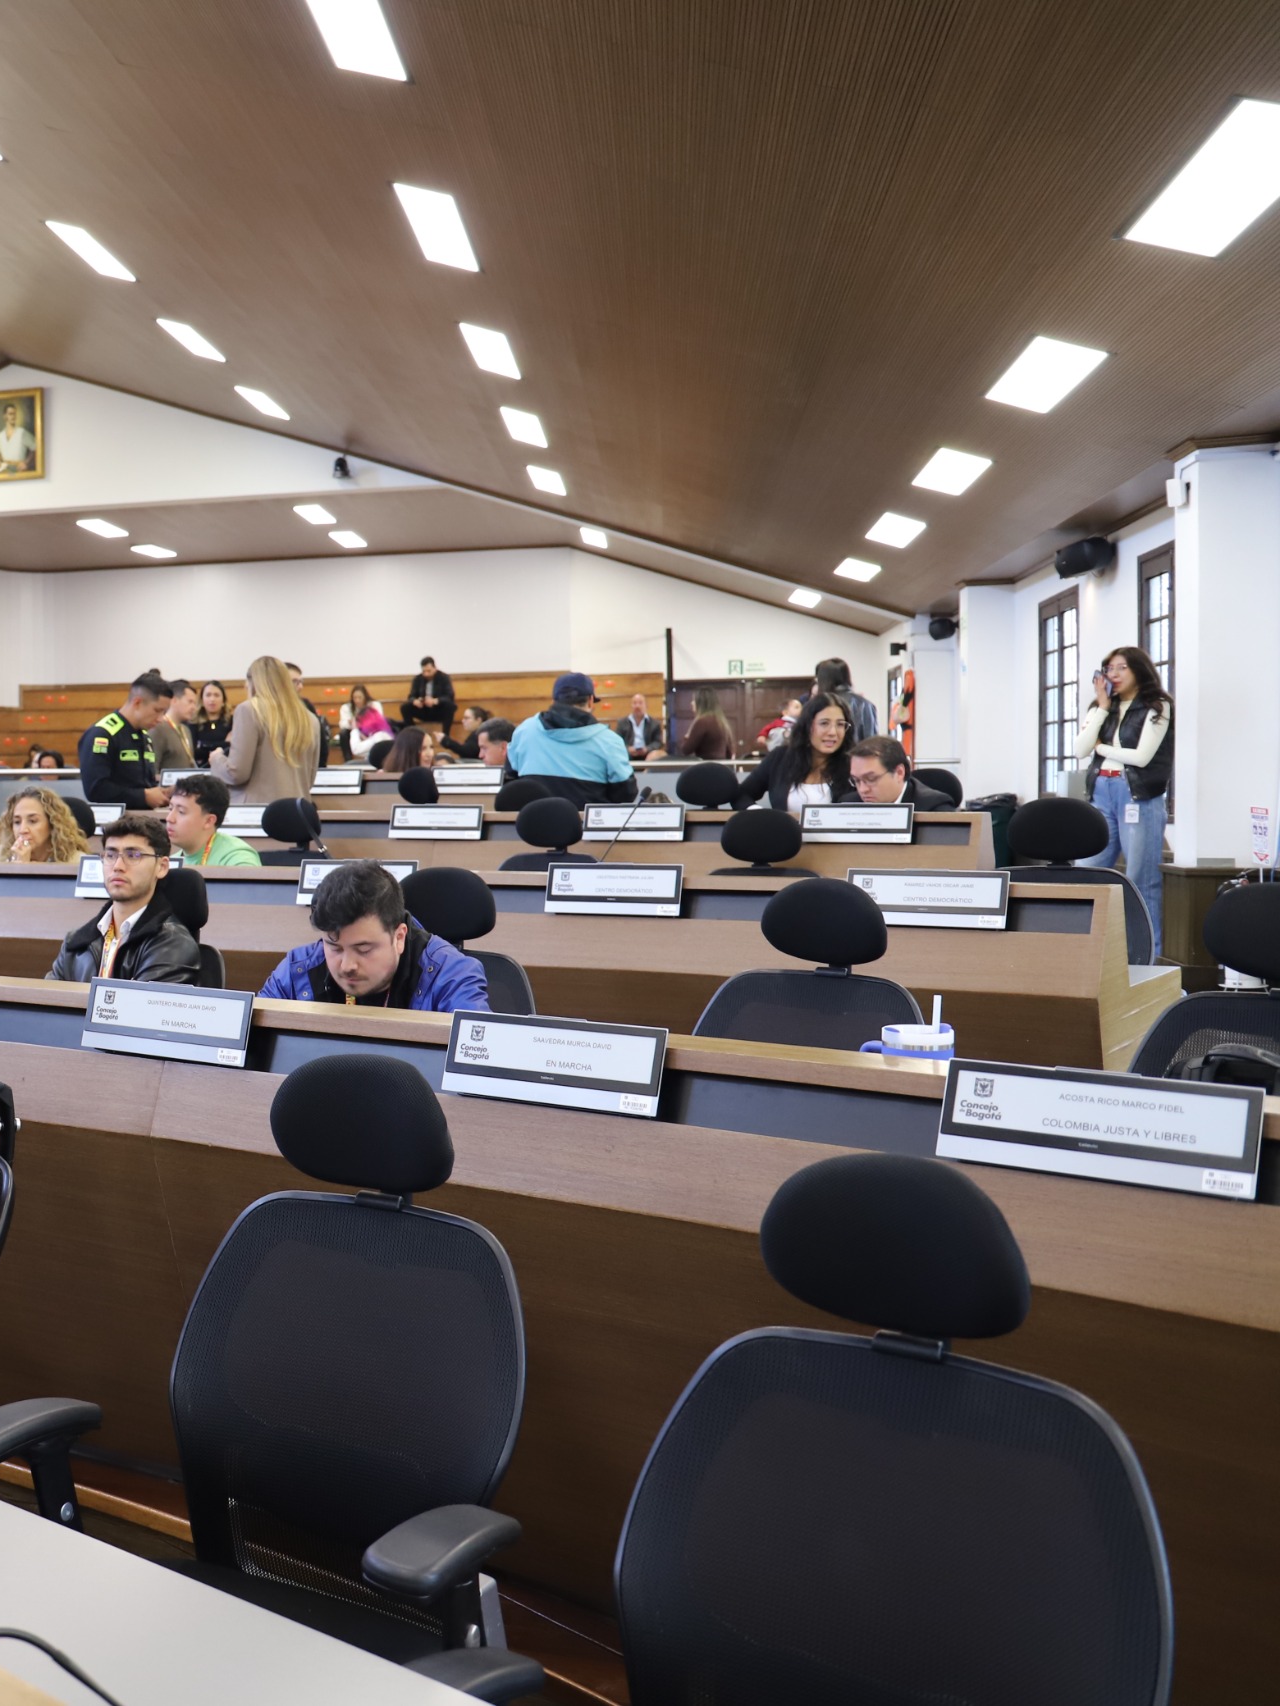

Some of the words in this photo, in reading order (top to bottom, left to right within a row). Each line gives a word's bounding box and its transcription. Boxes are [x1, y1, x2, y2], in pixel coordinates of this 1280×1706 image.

[161, 1019, 170, 1027] EN
[171, 1021, 197, 1030] MARCHA
[460, 1043, 488, 1054] Concejo
[532, 1036, 566, 1046] SAAVEDRA
[566, 1039, 592, 1049] MURCIA
[592, 1041, 612, 1051] DAVID
[464, 1050, 490, 1061] Bogotá
[545, 1059, 558, 1068] EN
[558, 1061, 593, 1072] MARCHA
[960, 1099, 999, 1113] Concejo
[1059, 1093, 1096, 1104] ACOSTA
[1096, 1096, 1120, 1107] RICO
[1121, 1099, 1157, 1111] MARCO
[1158, 1103, 1185, 1114] FIDEL
[965, 1108, 1002, 1121] Bogotá
[1041, 1117, 1100, 1133] COLOMBIA
[1103, 1124, 1140, 1138] JUSTA
[1142, 1128, 1151, 1139] Y
[1153, 1130, 1198, 1145] LIBRES
